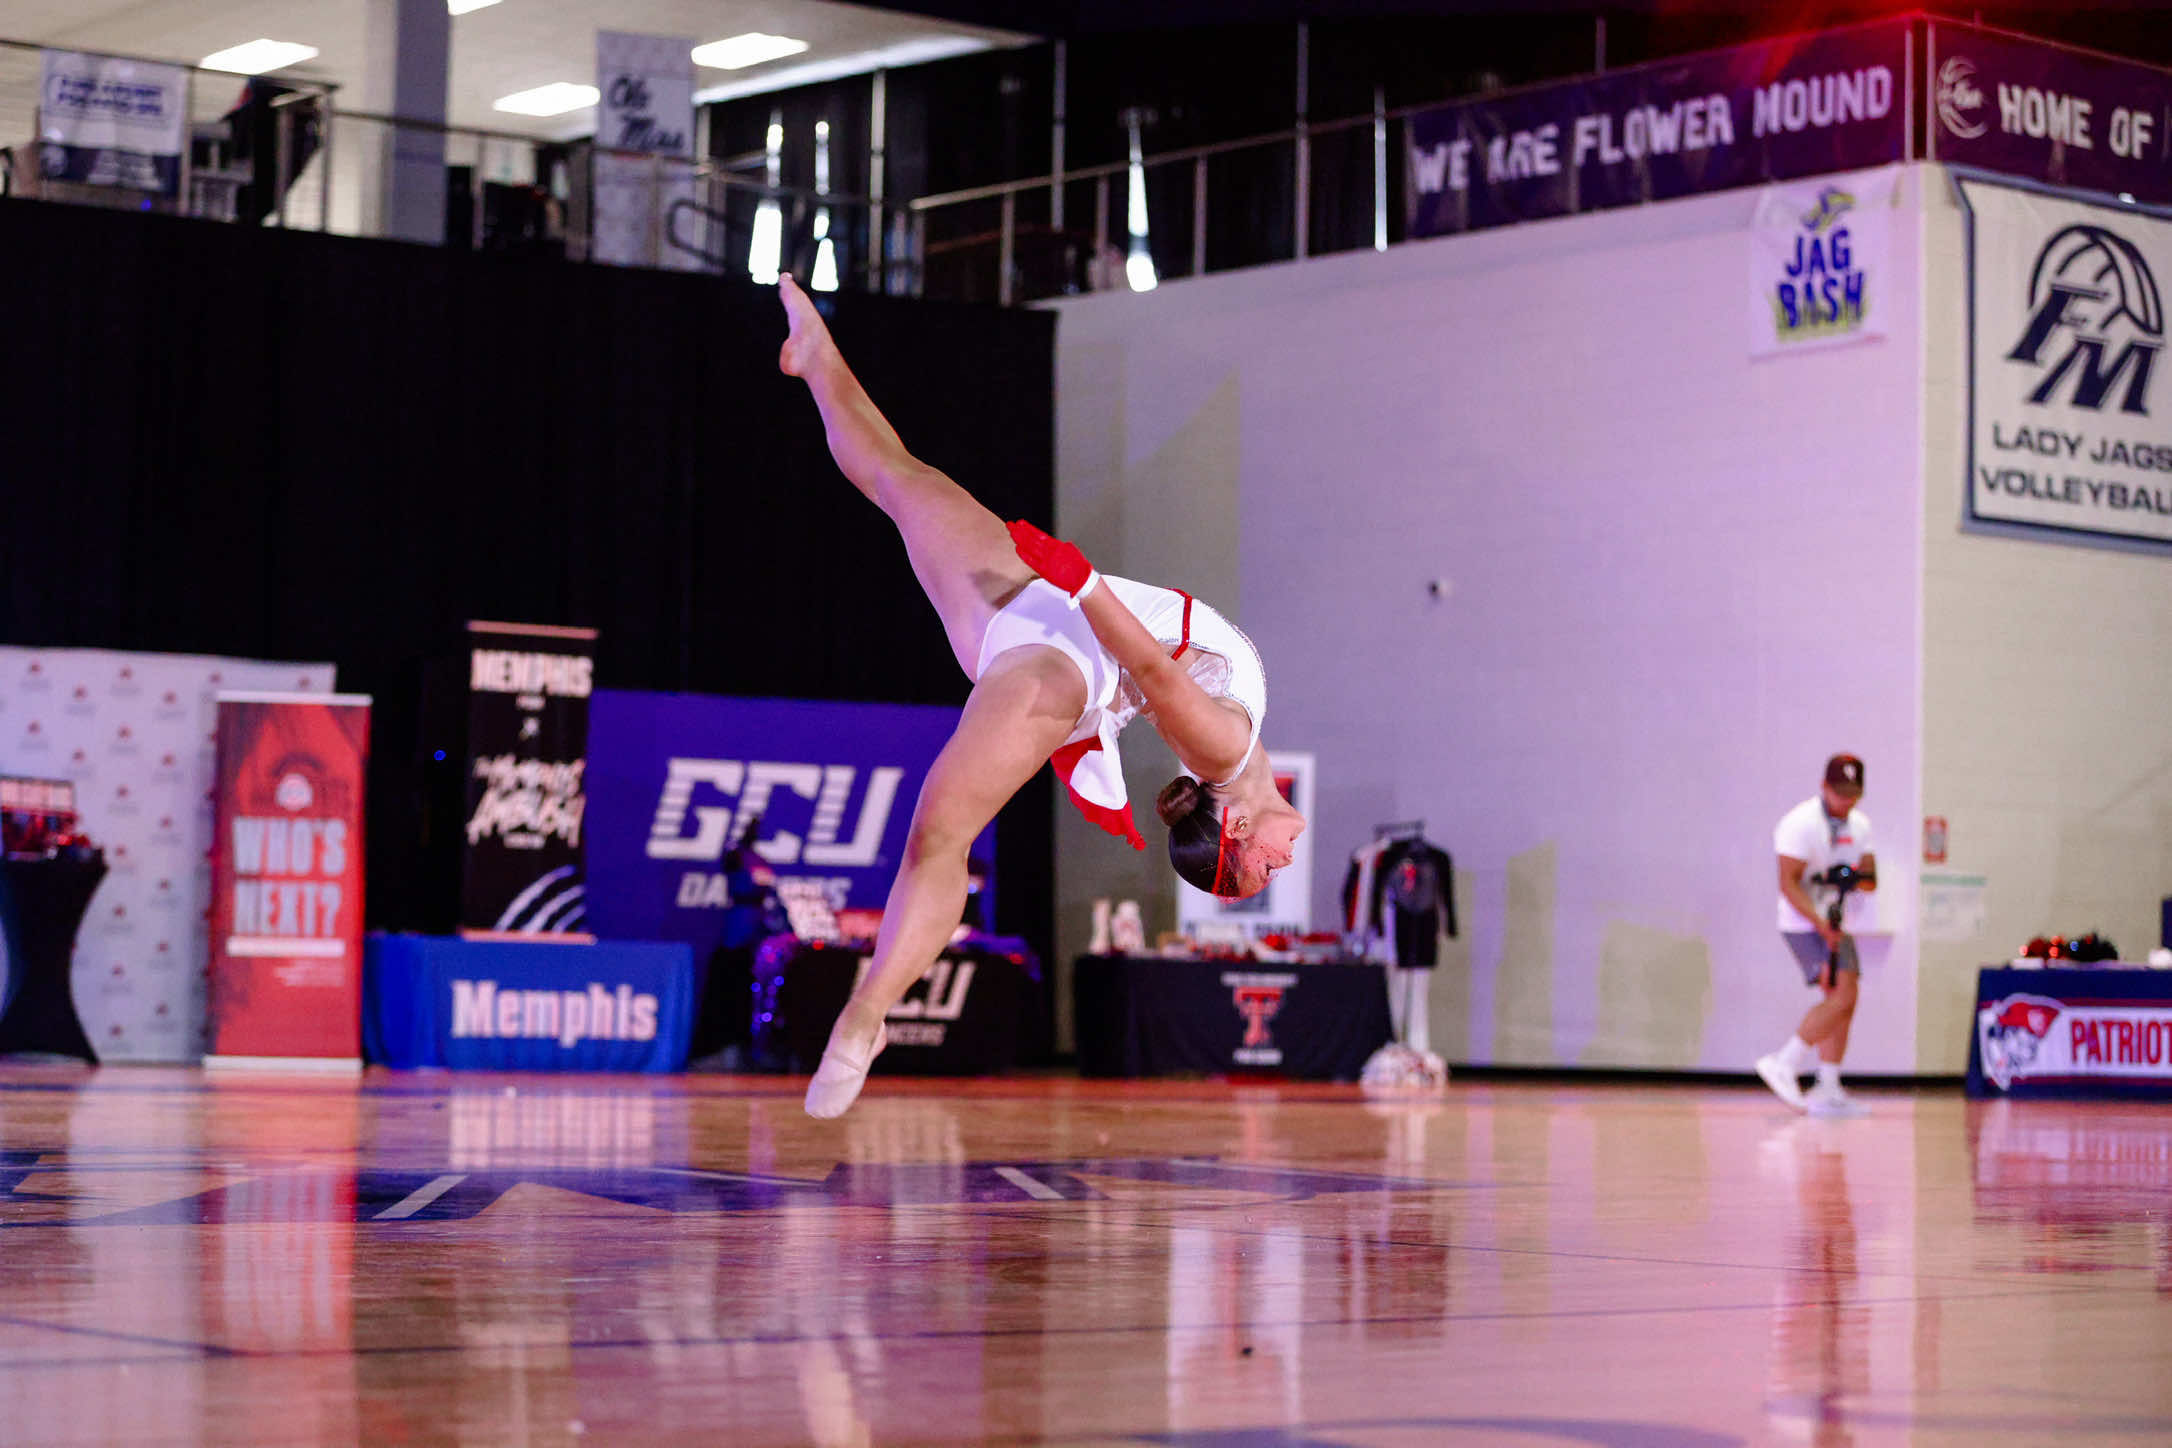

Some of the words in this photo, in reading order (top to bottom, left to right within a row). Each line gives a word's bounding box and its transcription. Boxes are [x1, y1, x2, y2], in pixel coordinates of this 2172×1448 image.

[1413, 138, 1471, 193] WE
[1487, 122, 1562, 184] ARE
[1573, 93, 1735, 168] FLOWER
[1752, 64, 1892, 138] MOUND
[1997, 82, 2094, 150] HOME
[2109, 106, 2154, 160] OF
[1785, 227, 1852, 280] JAG
[1778, 272, 1865, 329] BASH
[1993, 423, 2083, 460] LADY
[2090, 436, 2172, 474] JAGS
[1980, 465, 2172, 517] VOLLEYBAL
[470, 648, 593, 698] MEMPHIS
[645, 757, 904, 866] GCU
[232, 815, 347, 877] WHO'S
[232, 879, 342, 937] NEXT?
[452, 978, 659, 1049] Memphis
